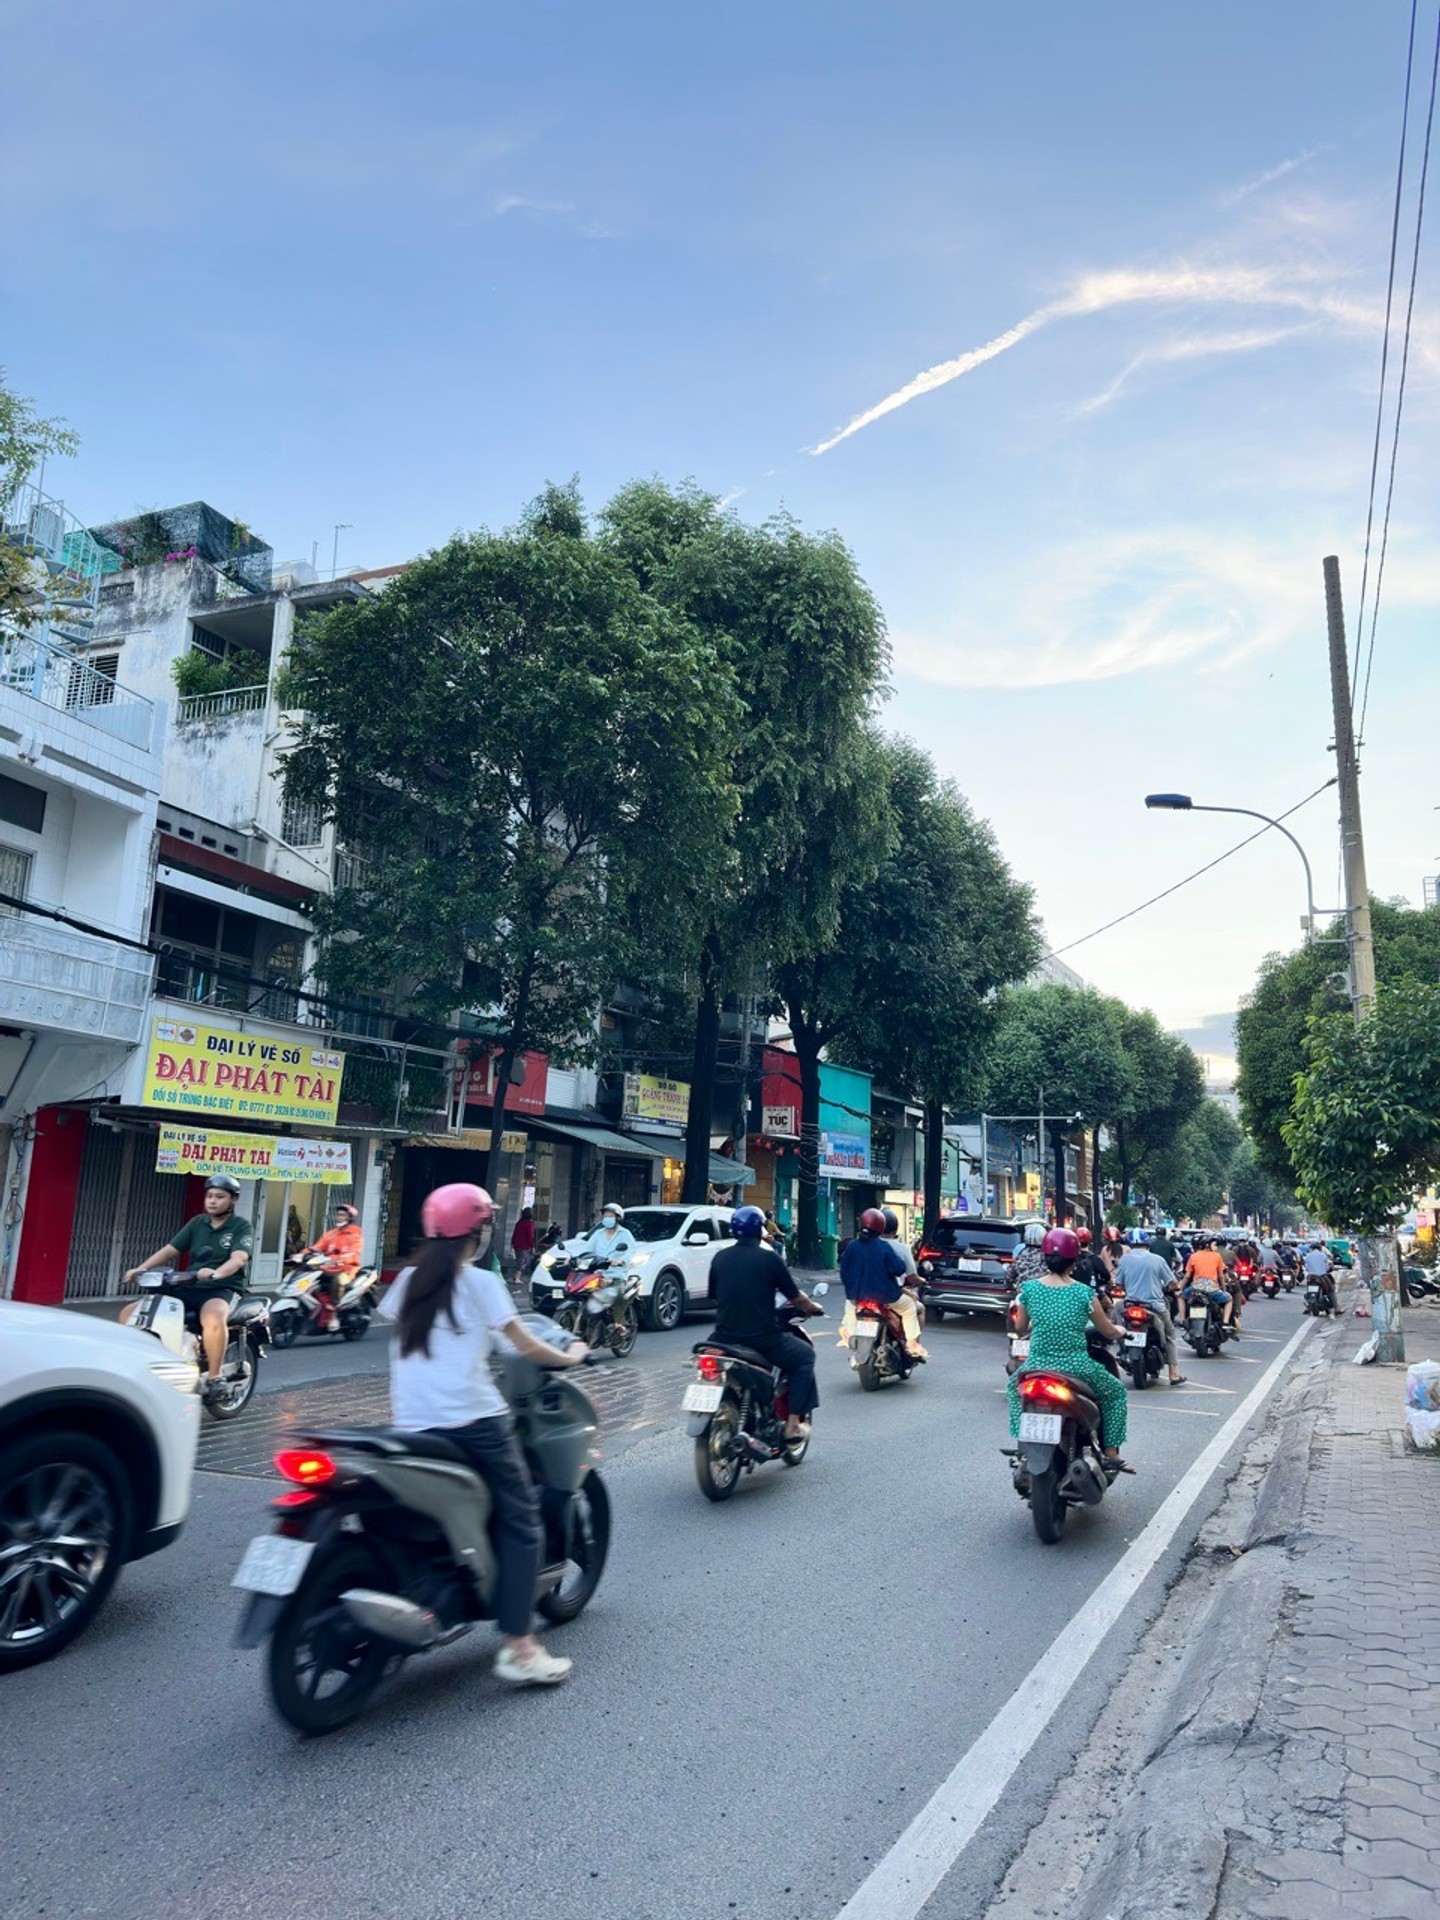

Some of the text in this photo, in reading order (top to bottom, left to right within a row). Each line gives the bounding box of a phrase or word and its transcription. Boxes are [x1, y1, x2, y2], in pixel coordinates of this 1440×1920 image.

[206, 1035, 302, 1065] ĐẠI LÝ VÉ SỐ
[155, 1053, 209, 1089] ĐẠI
[294, 1071, 335, 1102] TÀI
[181, 1143, 207, 1163] ĐẠI
[209, 1144, 246, 1163] PHÁT
